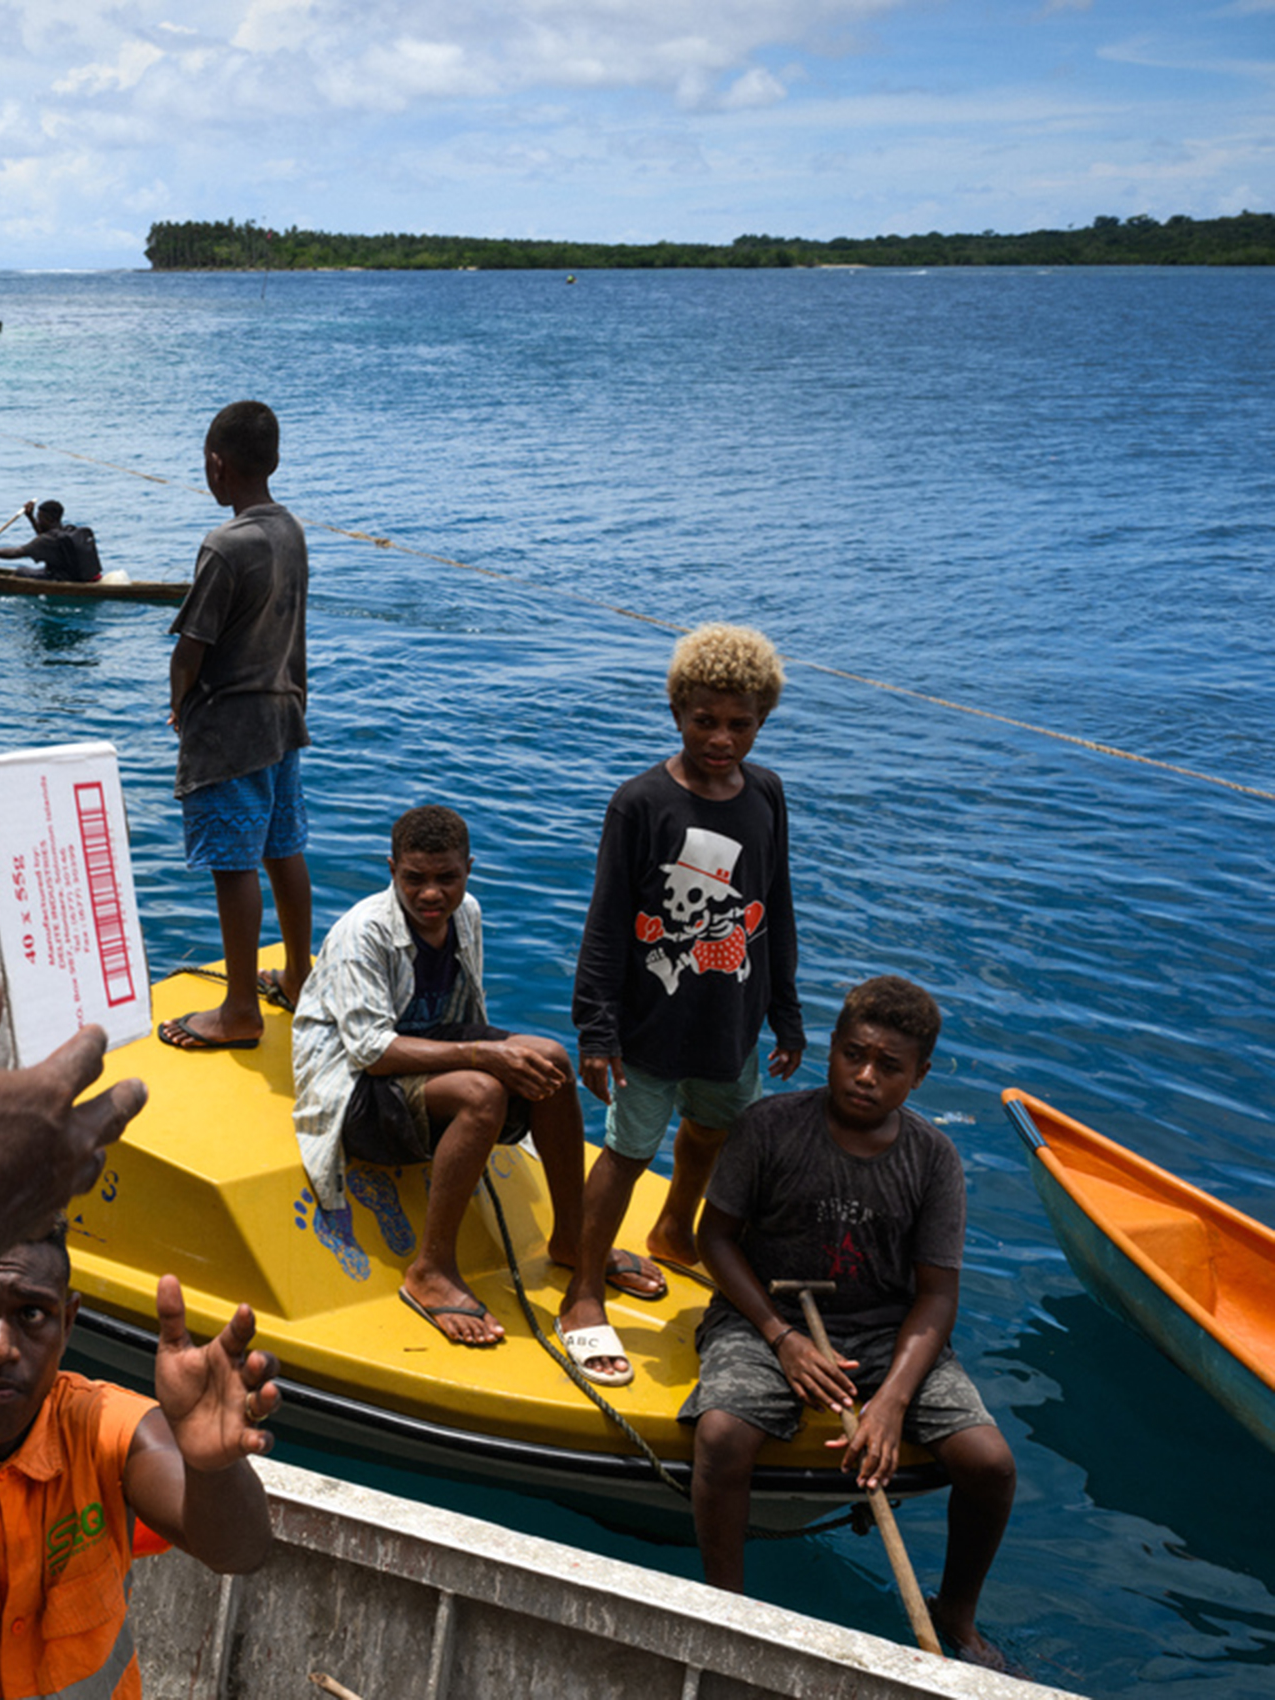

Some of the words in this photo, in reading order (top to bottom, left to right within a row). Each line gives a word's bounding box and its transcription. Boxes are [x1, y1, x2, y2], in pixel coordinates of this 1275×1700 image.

[40, 775, 52, 821] Islands
[47, 825, 61, 884] Solomon
[12, 854, 29, 903] 55g
[39, 839, 58, 919] INDUSTRIES
[34, 870, 55, 965] Manufactured
[21, 934, 36, 965] 40
[52, 923, 66, 969] DELITE
[70, 977, 80, 1002] Box
[566, 1335, 600, 1348] ABC
